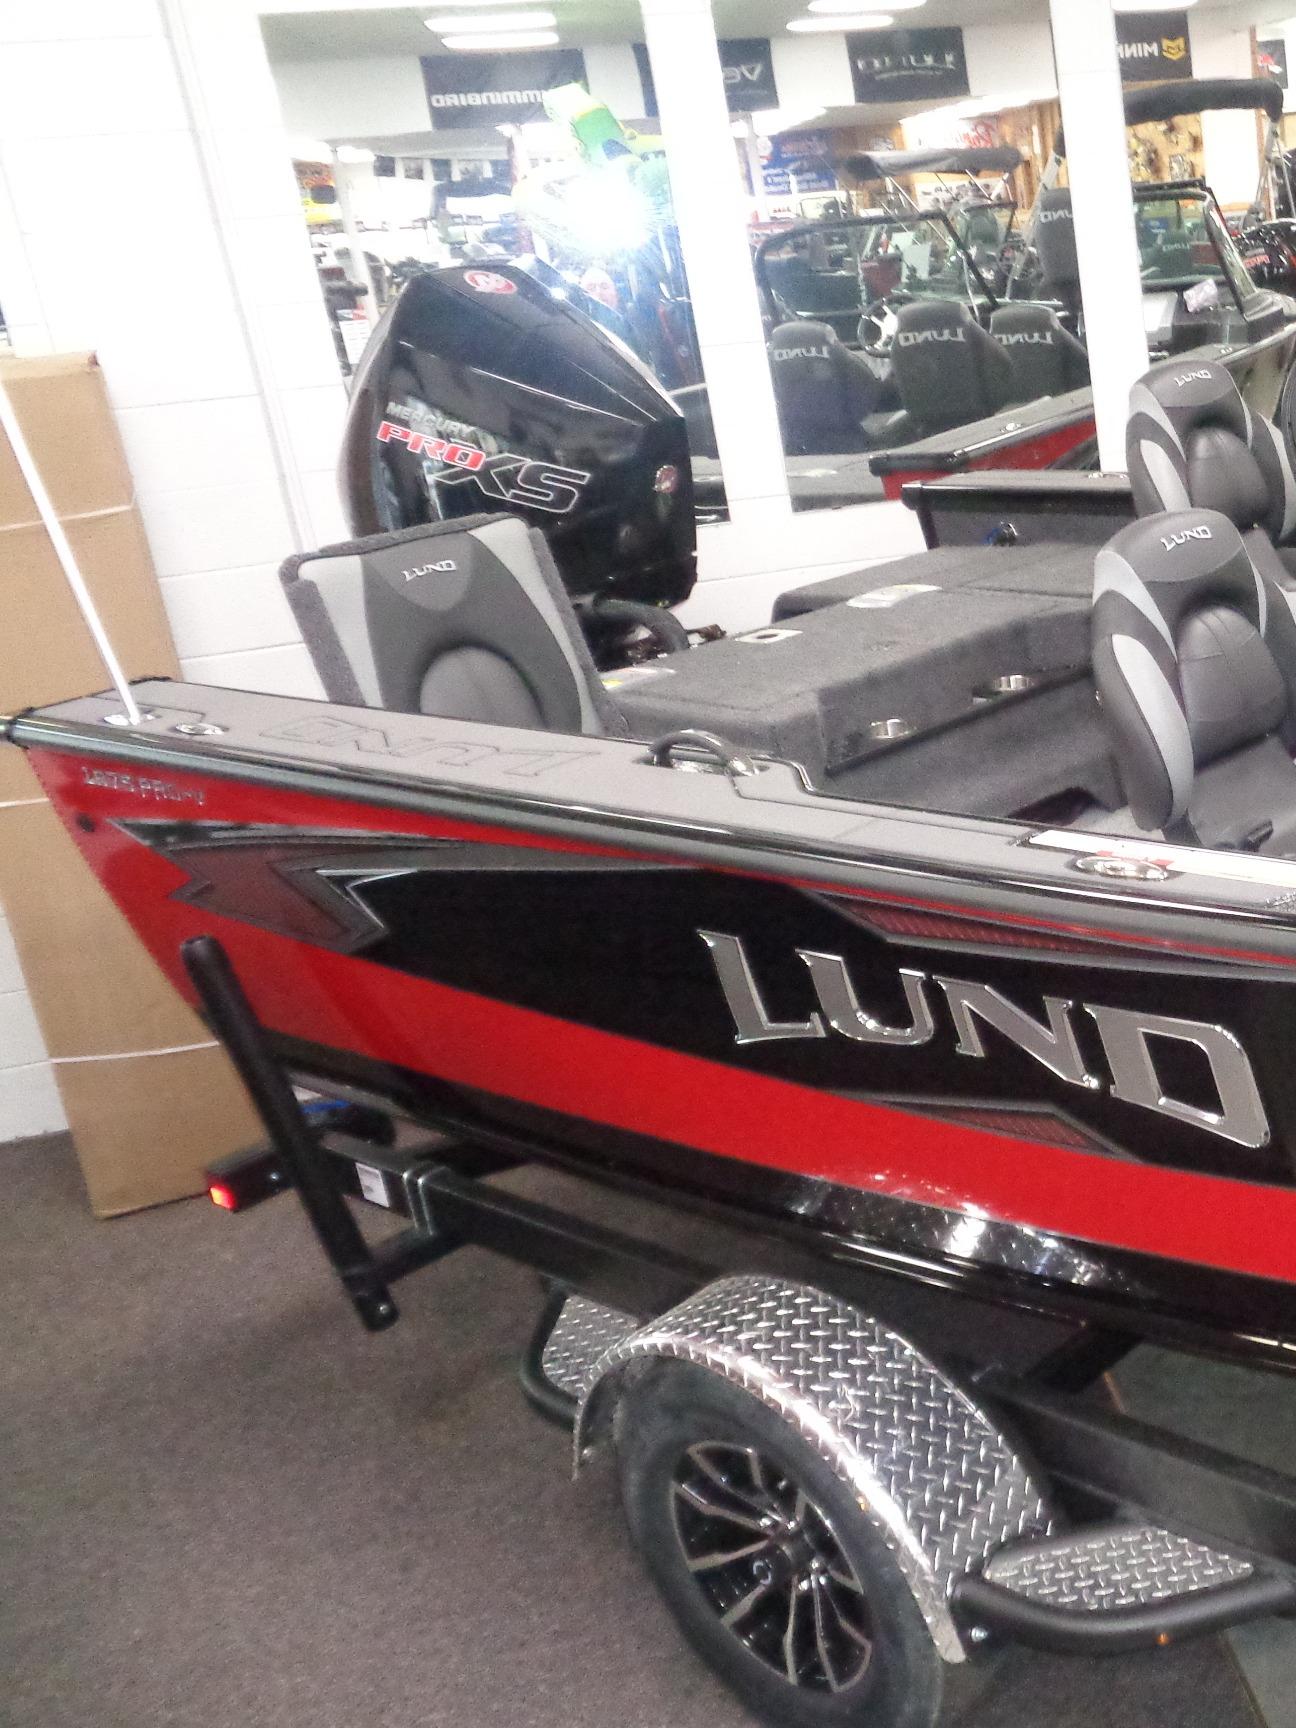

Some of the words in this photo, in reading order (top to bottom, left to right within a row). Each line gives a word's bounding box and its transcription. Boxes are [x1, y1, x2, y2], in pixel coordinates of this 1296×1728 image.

[1174, 369, 1212, 387] LUND
[376, 421, 486, 471] PRO
[430, 453, 591, 513] XS
[1160, 525, 1212, 551] LUND
[401, 559, 457, 581] LUND
[697, 929, 1271, 1149] LUND
